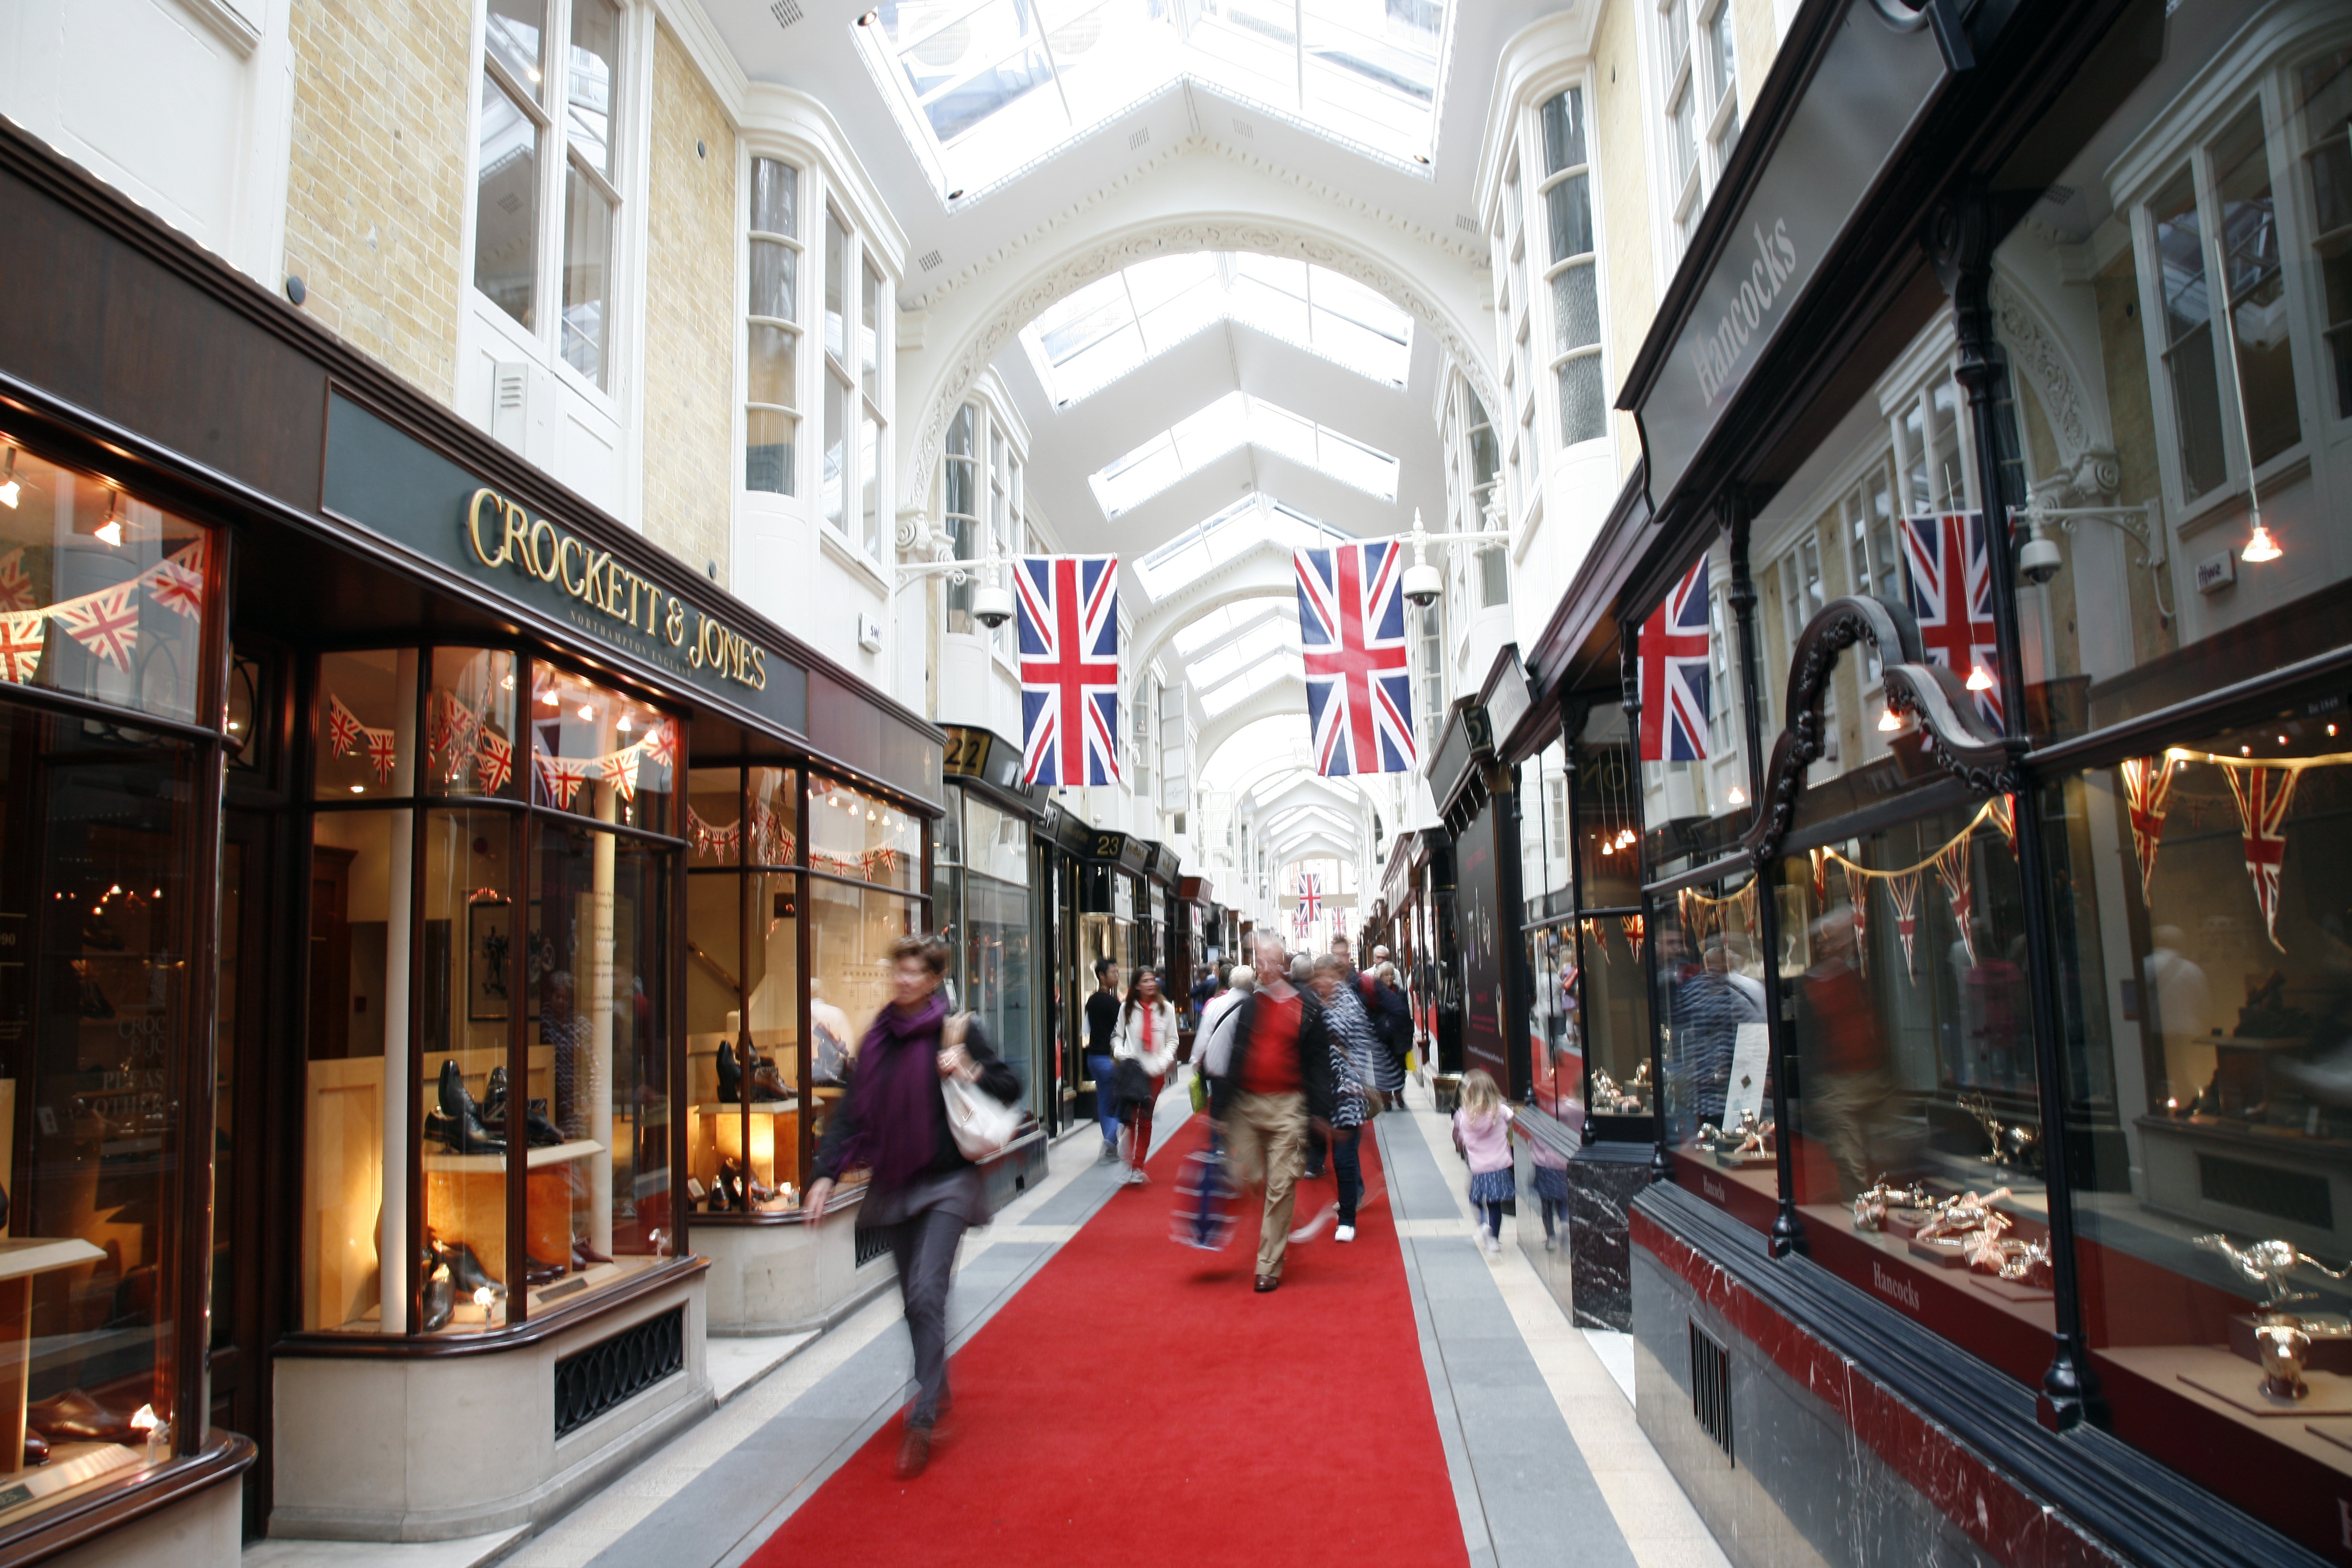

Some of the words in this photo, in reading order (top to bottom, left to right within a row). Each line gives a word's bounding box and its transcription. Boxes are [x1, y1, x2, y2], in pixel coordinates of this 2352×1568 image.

[1689, 217, 1796, 408] Hancocks
[468, 487, 661, 636] CROCKETT
[666, 597, 684, 647] &
[689, 612, 766, 691] JONES
[570, 609, 647, 655] NORTHAMPTON
[652, 649, 691, 678] ENGLAND
[1468, 709, 1482, 747] 5
[944, 738, 980, 767] 22
[1097, 835, 1119, 856] 23
[1703, 1175, 1725, 1203] Hancocks
[1873, 1262, 1919, 1311] Hancocks
